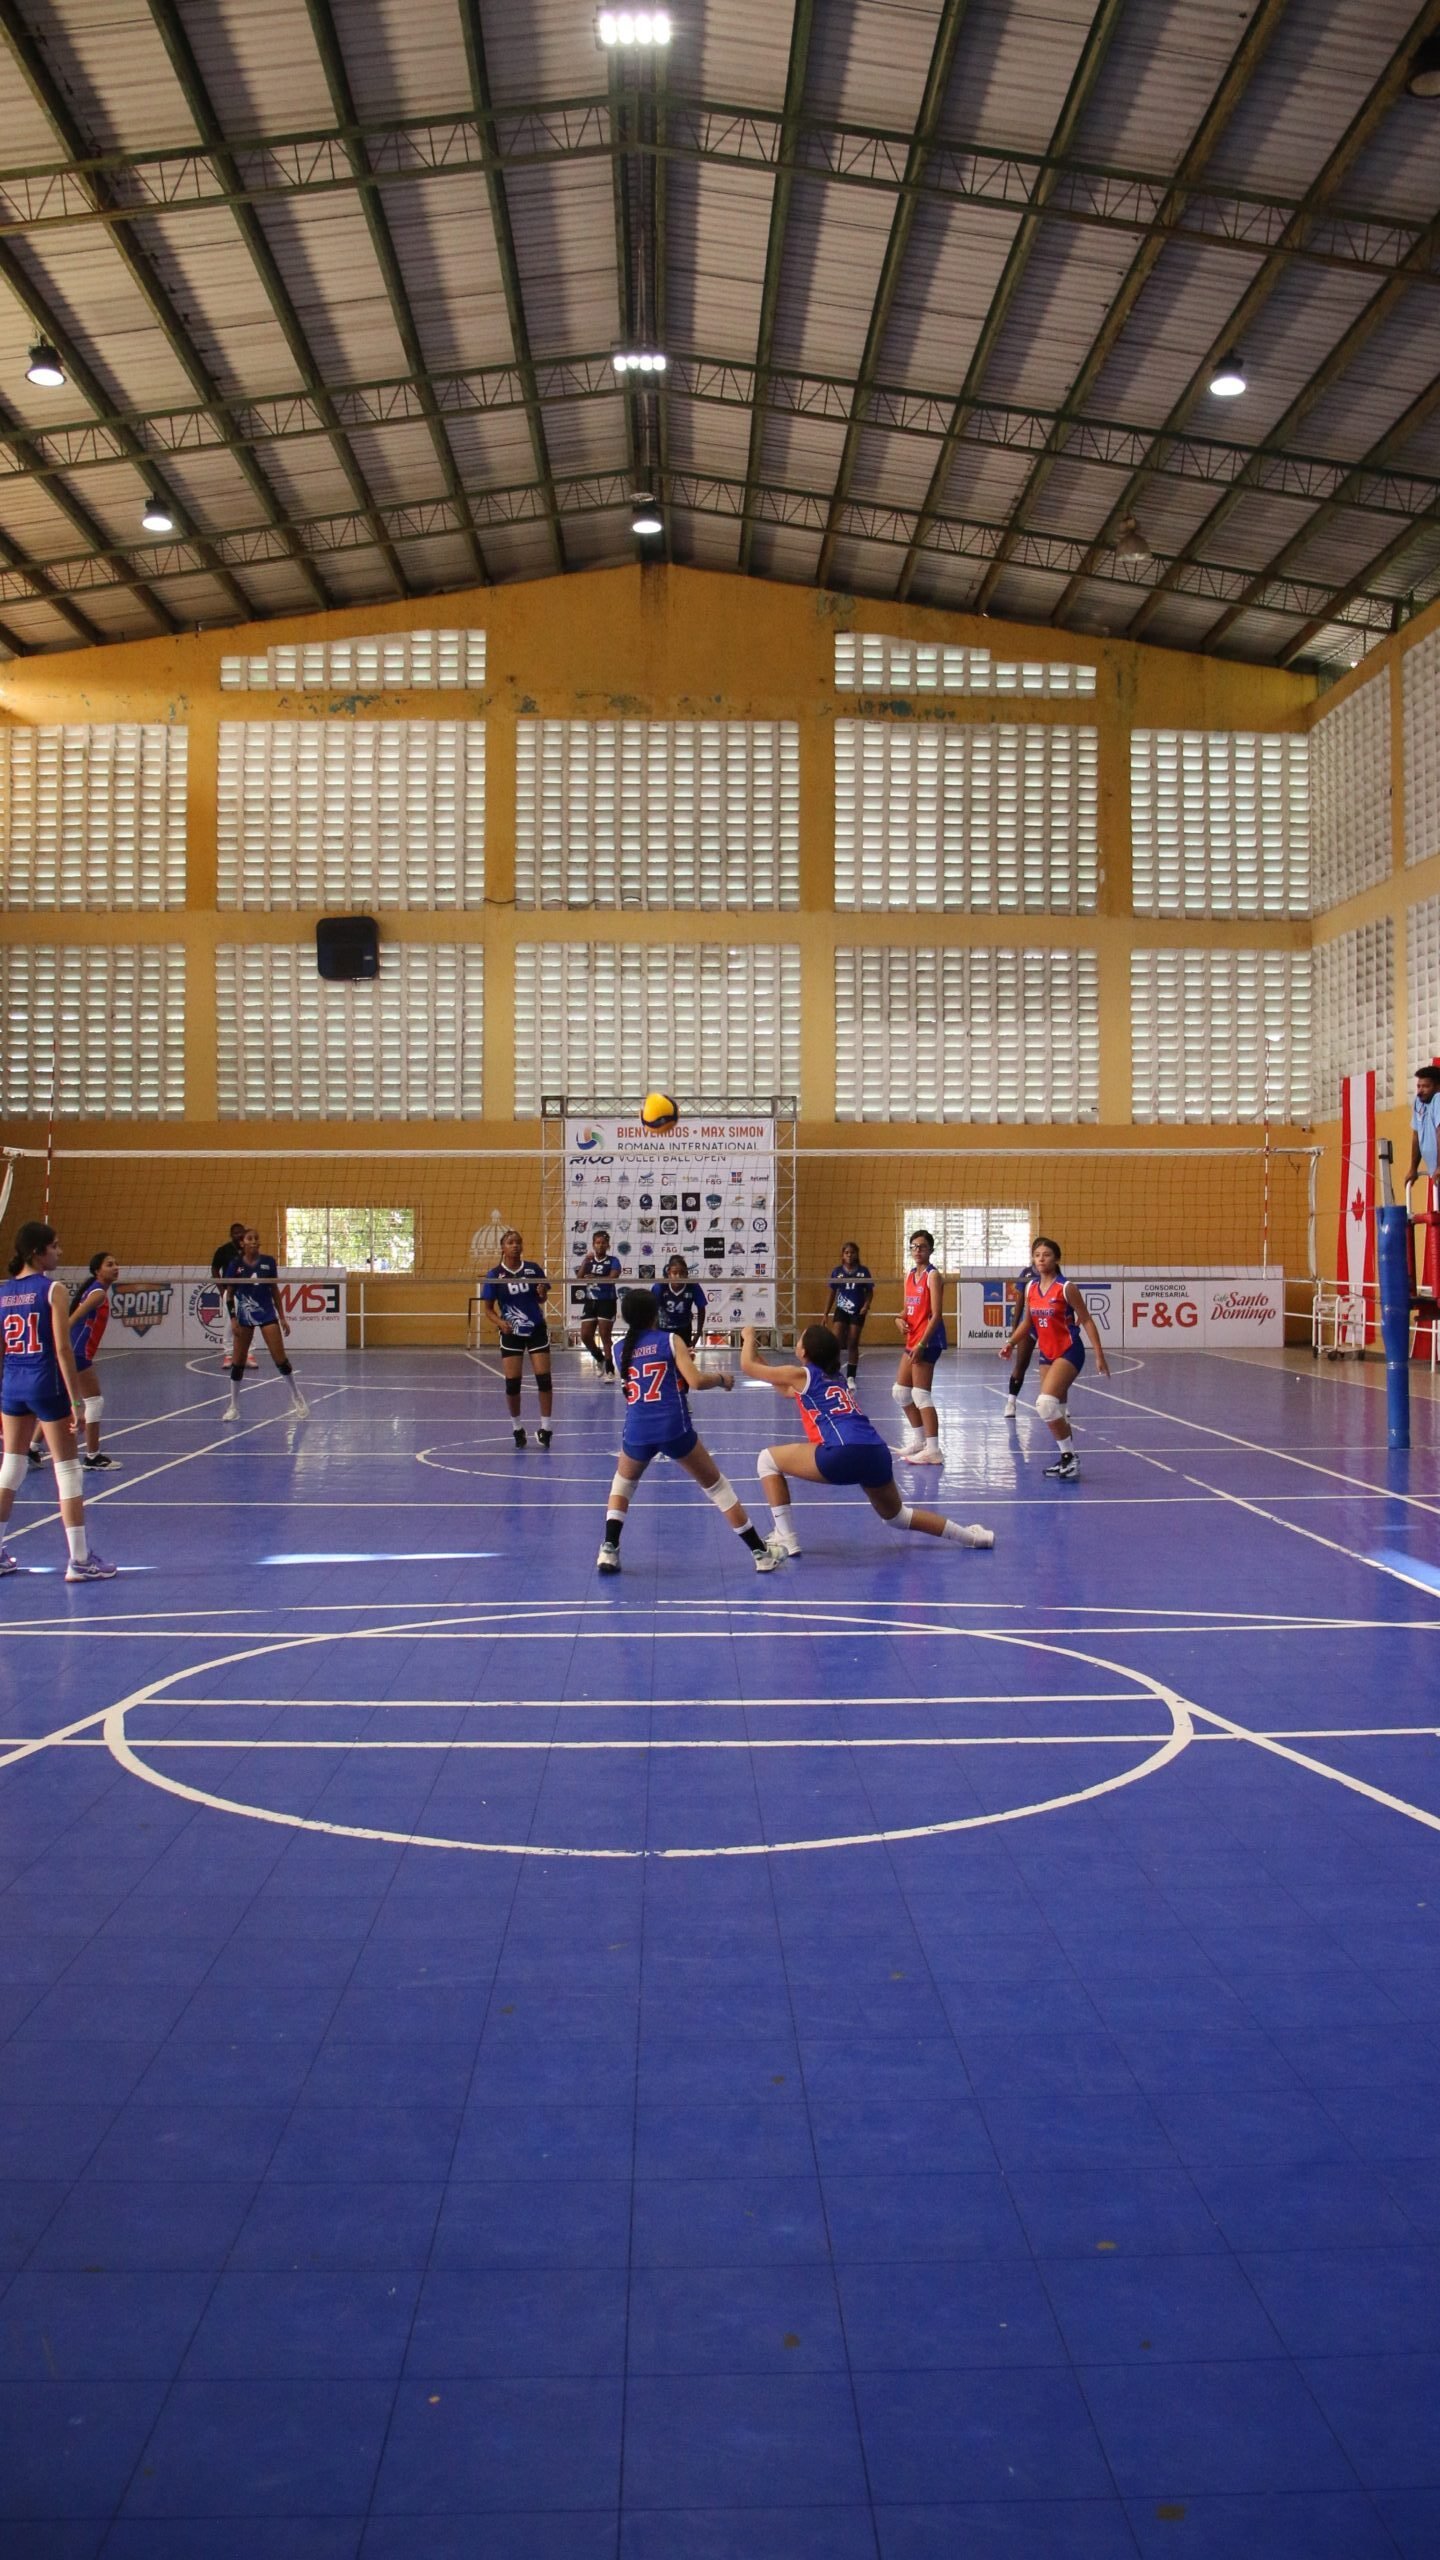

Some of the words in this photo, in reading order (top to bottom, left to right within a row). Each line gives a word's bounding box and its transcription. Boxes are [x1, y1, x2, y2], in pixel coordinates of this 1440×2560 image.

[701, 1127, 725, 1137] MAX
[729, 1126, 764, 1138] SIMON
[617, 1143, 665, 1151] ROMANA
[669, 1142, 757, 1151] INTERNATIONAL
[591, 1264, 604, 1274] 12
[1144, 1284, 1191, 1292] CONSORCIO
[1140, 1291, 1194, 1299] EMPRESARIAL
[1226, 1291, 1269, 1308] Santo
[111, 1289, 173, 1318] SPORT
[666, 1300, 685, 1313] 34
[1132, 1302, 1199, 1328] F&G
[1210, 1303, 1277, 1327] Domingo
[1038, 1317, 1049, 1328] 26
[3, 1312, 43, 1355] 21
[995, 1330, 1003, 1338] de
[626, 1361, 668, 1405] 67
